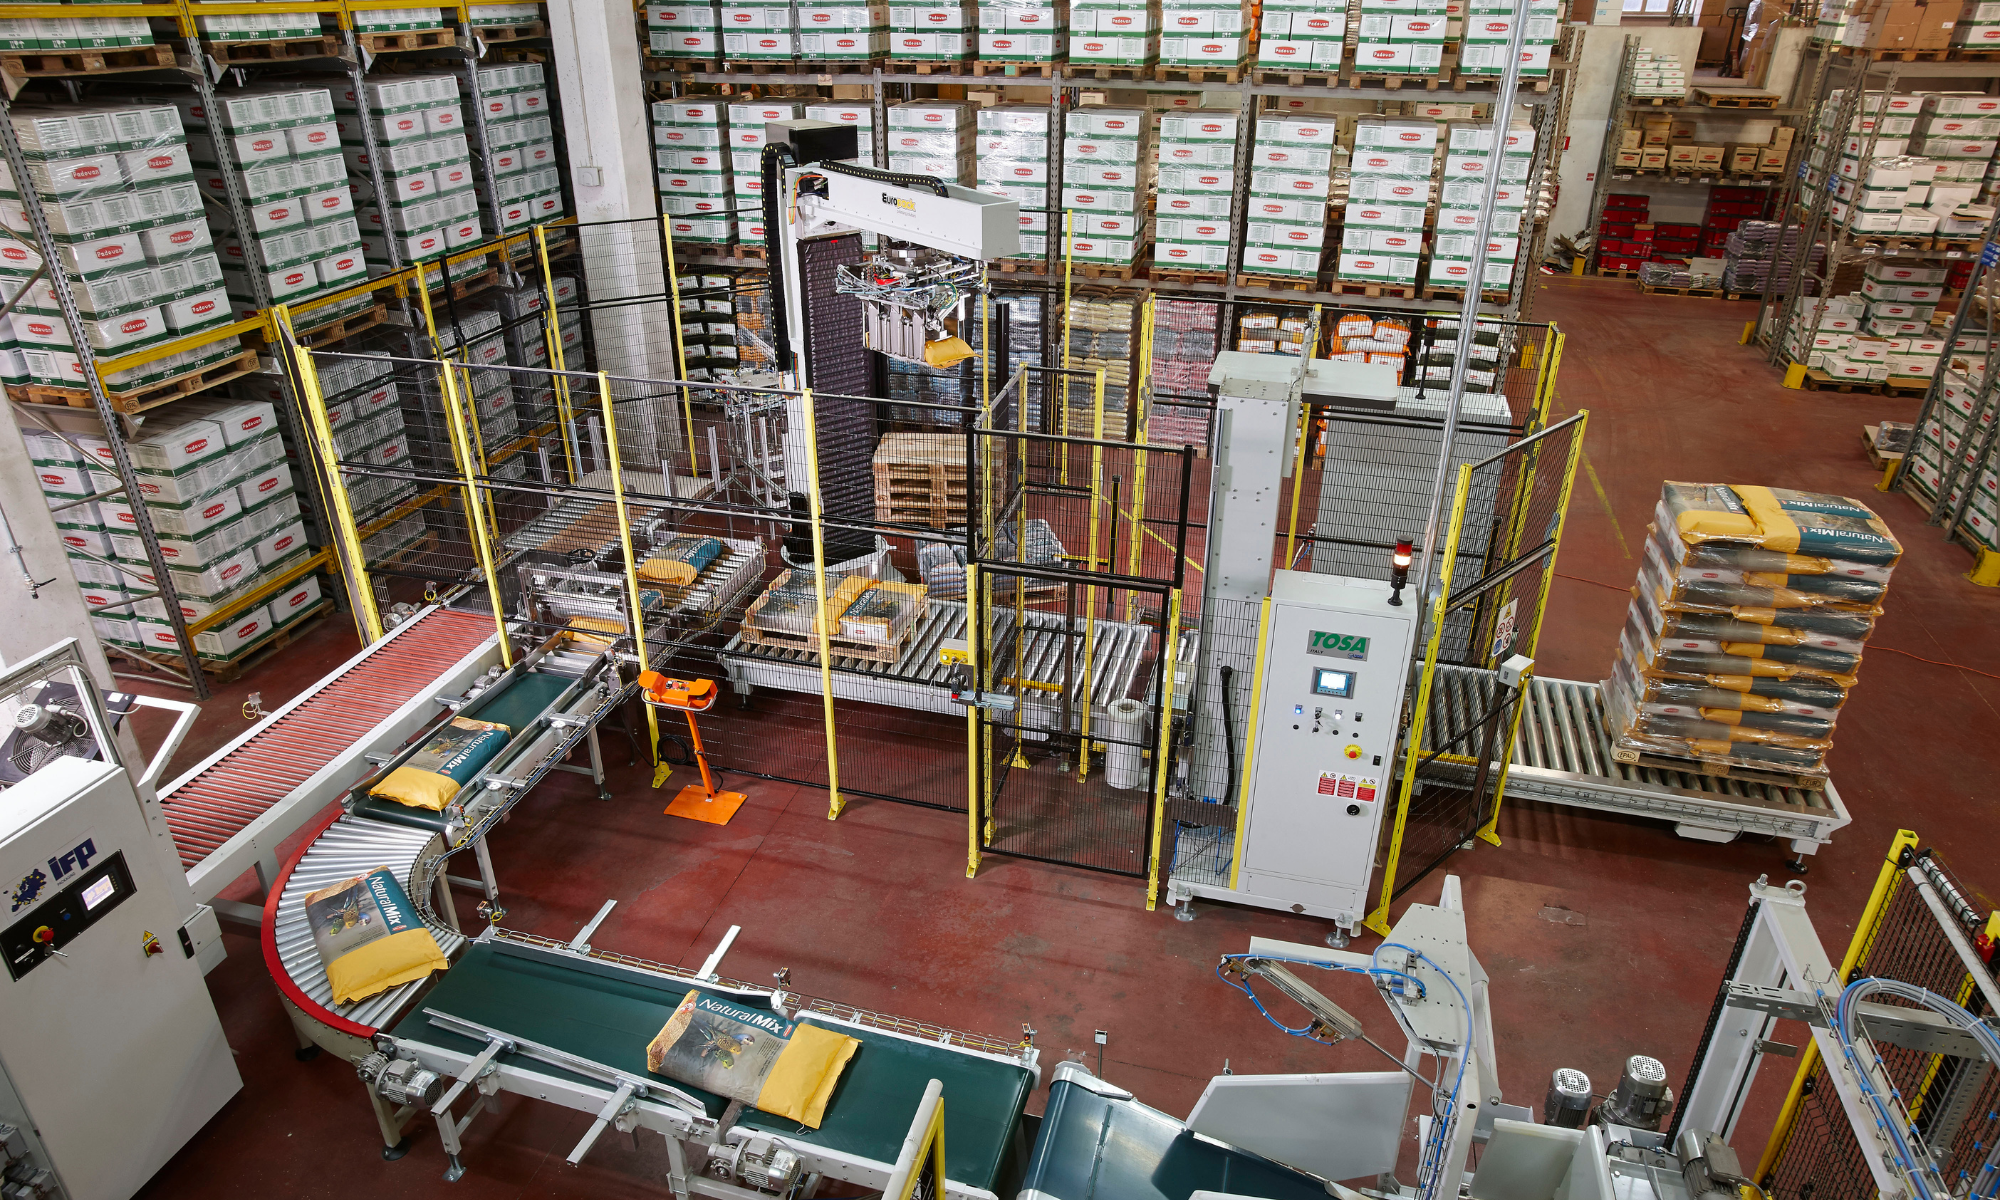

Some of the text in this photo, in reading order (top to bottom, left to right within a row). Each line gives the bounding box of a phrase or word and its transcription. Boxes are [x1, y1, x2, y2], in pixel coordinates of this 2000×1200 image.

[308, 133, 325, 141] Padovan
[252, 142, 272, 150] Padovan
[148, 158, 172, 167] Padovan
[73, 168, 99, 178] Padovan
[322, 198, 339, 206] Padovan
[269, 210, 288, 219] Padovan
[170, 232, 193, 242] Padovan
[1, 249, 26, 258] Padovan
[96, 247, 123, 258] Padovan
[336, 260, 353, 269] Padovan
[285, 274, 303, 283] Padovan
[191, 302, 214, 313] Padovan
[27, 325, 52, 334] Padovan
[121, 321, 146, 332] Padovan
[242, 418, 261, 429] Padovan
[185, 440, 207, 452] Padovan
[259, 479, 277, 490] Padovan
[202, 505, 224, 517] Padovan
[1789, 500, 1860, 512] NaturalMix
[1809, 526, 1884, 544] NaturalMix
[274, 537, 292, 549] Padovan
[290, 593, 306, 605] Padovan
[238, 623, 257, 636] Padovan
[1312, 631, 1367, 653] TOSA
[446, 732, 493, 770] NaturalMix
[369, 876, 400, 925] NaturalMix
[699, 998, 783, 1034] NaturalMix
